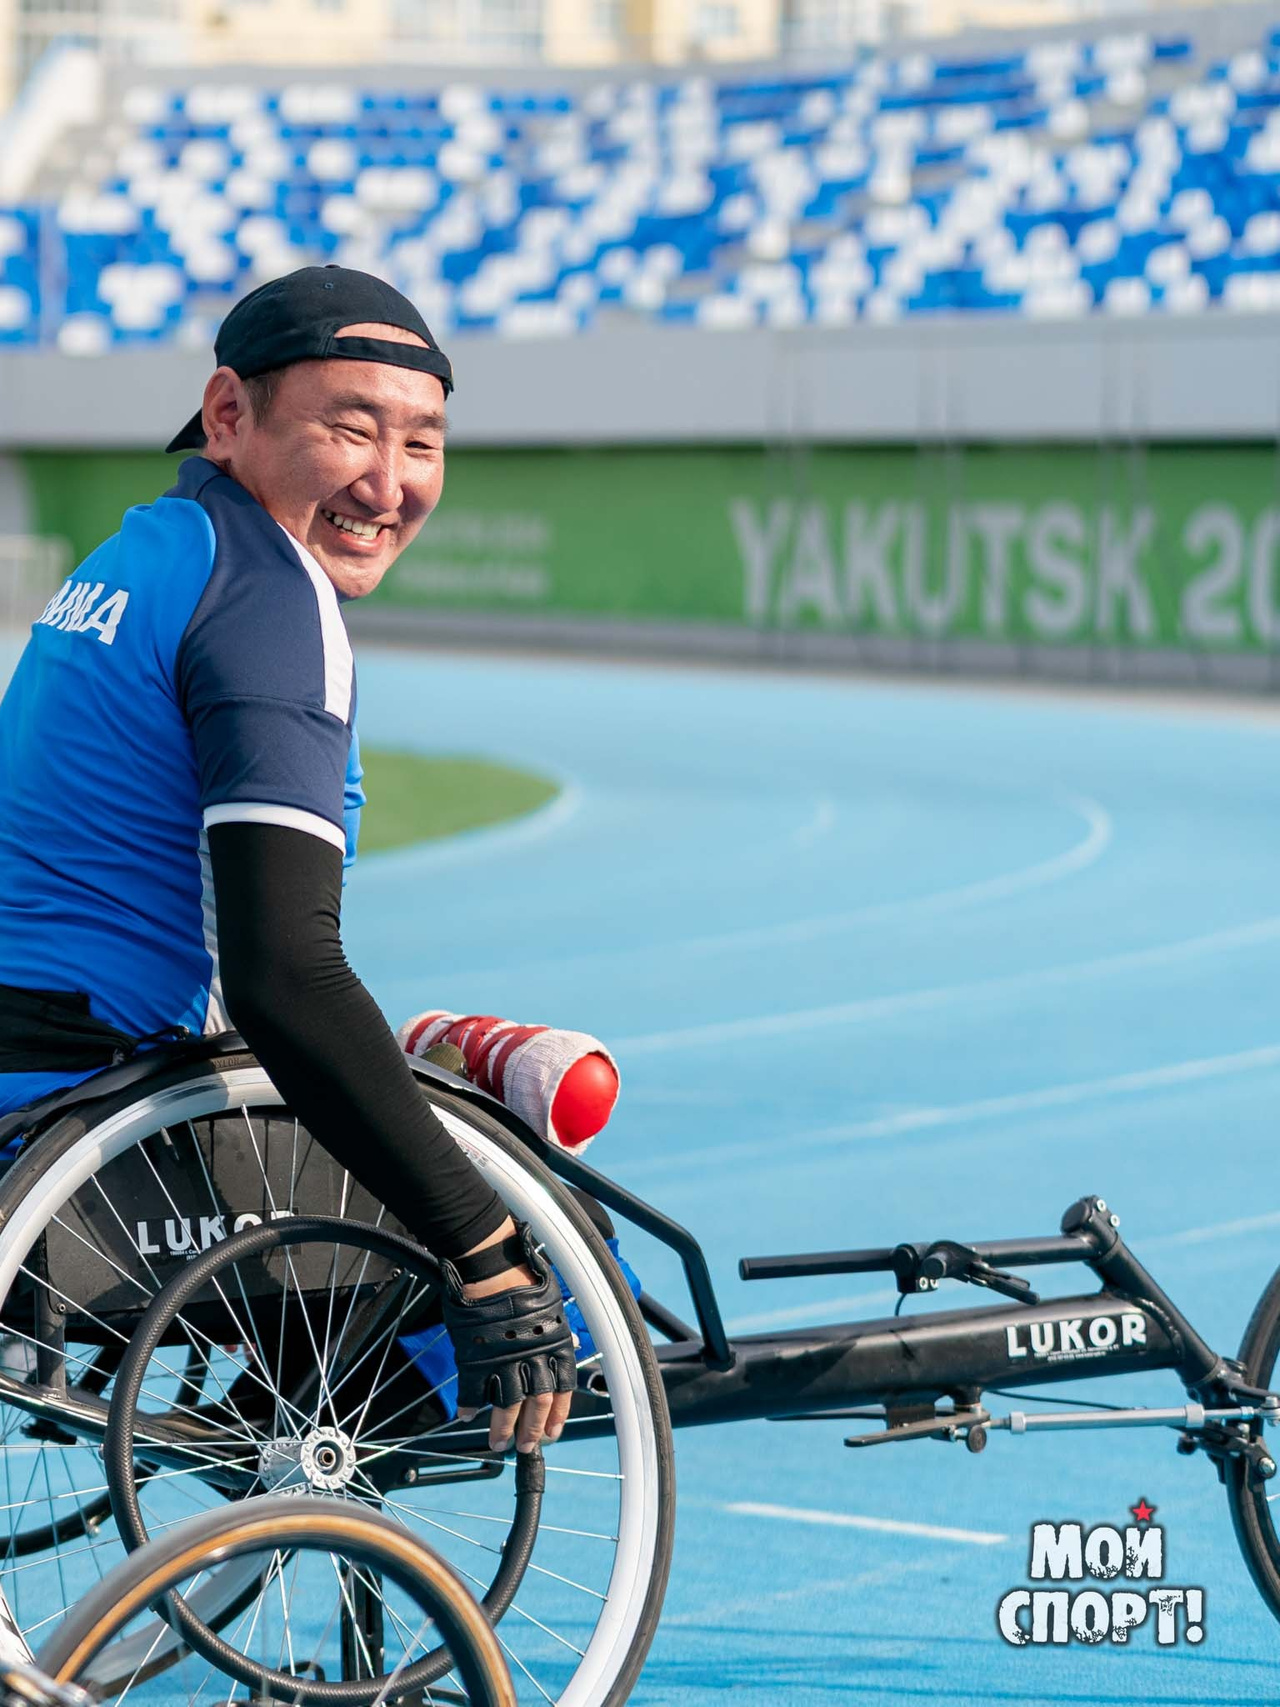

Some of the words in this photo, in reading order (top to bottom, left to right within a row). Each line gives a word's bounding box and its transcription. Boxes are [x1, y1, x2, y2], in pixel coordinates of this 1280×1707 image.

[727, 498, 1156, 634] YAKUTSK
[137, 1210, 295, 1254] LUK
[1006, 1314, 1147, 1358] LUKOR
